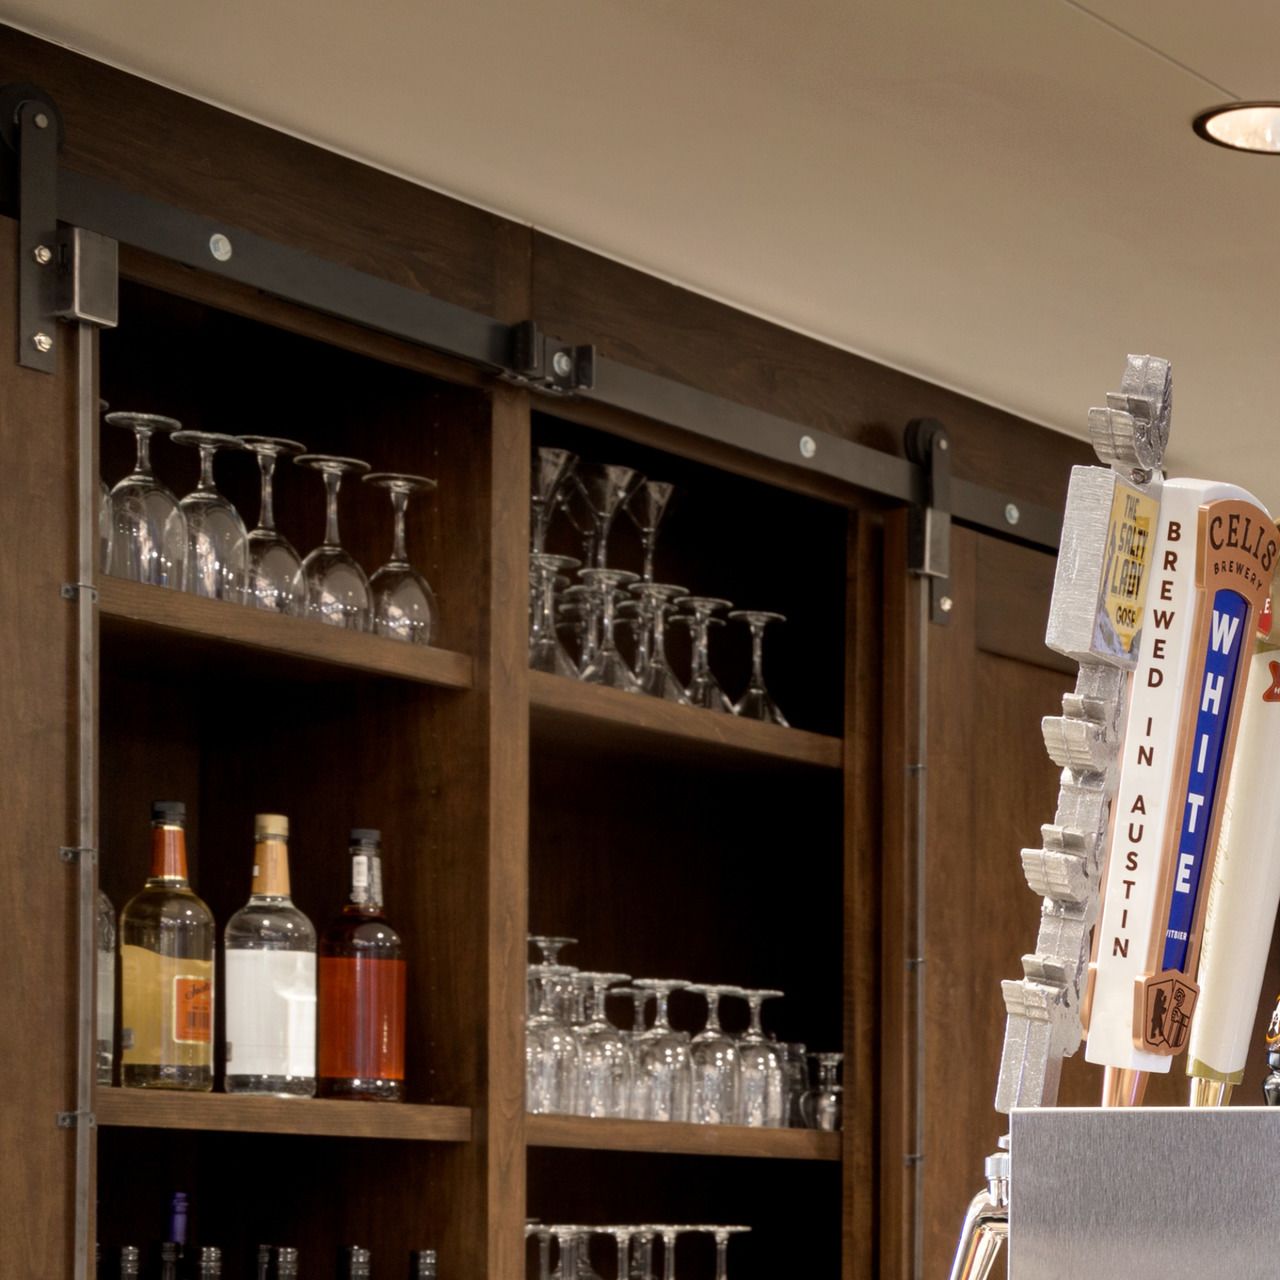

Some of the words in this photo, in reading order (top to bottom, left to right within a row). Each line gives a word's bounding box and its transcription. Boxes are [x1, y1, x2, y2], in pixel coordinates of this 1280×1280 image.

[1124, 494, 1141, 521] THE
[1118, 523, 1149, 560] SALTY
[1209, 514, 1277, 572] CELIS
[1111, 555, 1145, 600] LADY
[1213, 560, 1263, 591] BREWERY
[1116, 605, 1137, 629] GOSE
[1148, 521, 1181, 687] BREWED
[1137, 716, 1154, 767] IN
[1175, 609, 1240, 893] WHITE
[1112, 795, 1146, 958] AUSTIN
